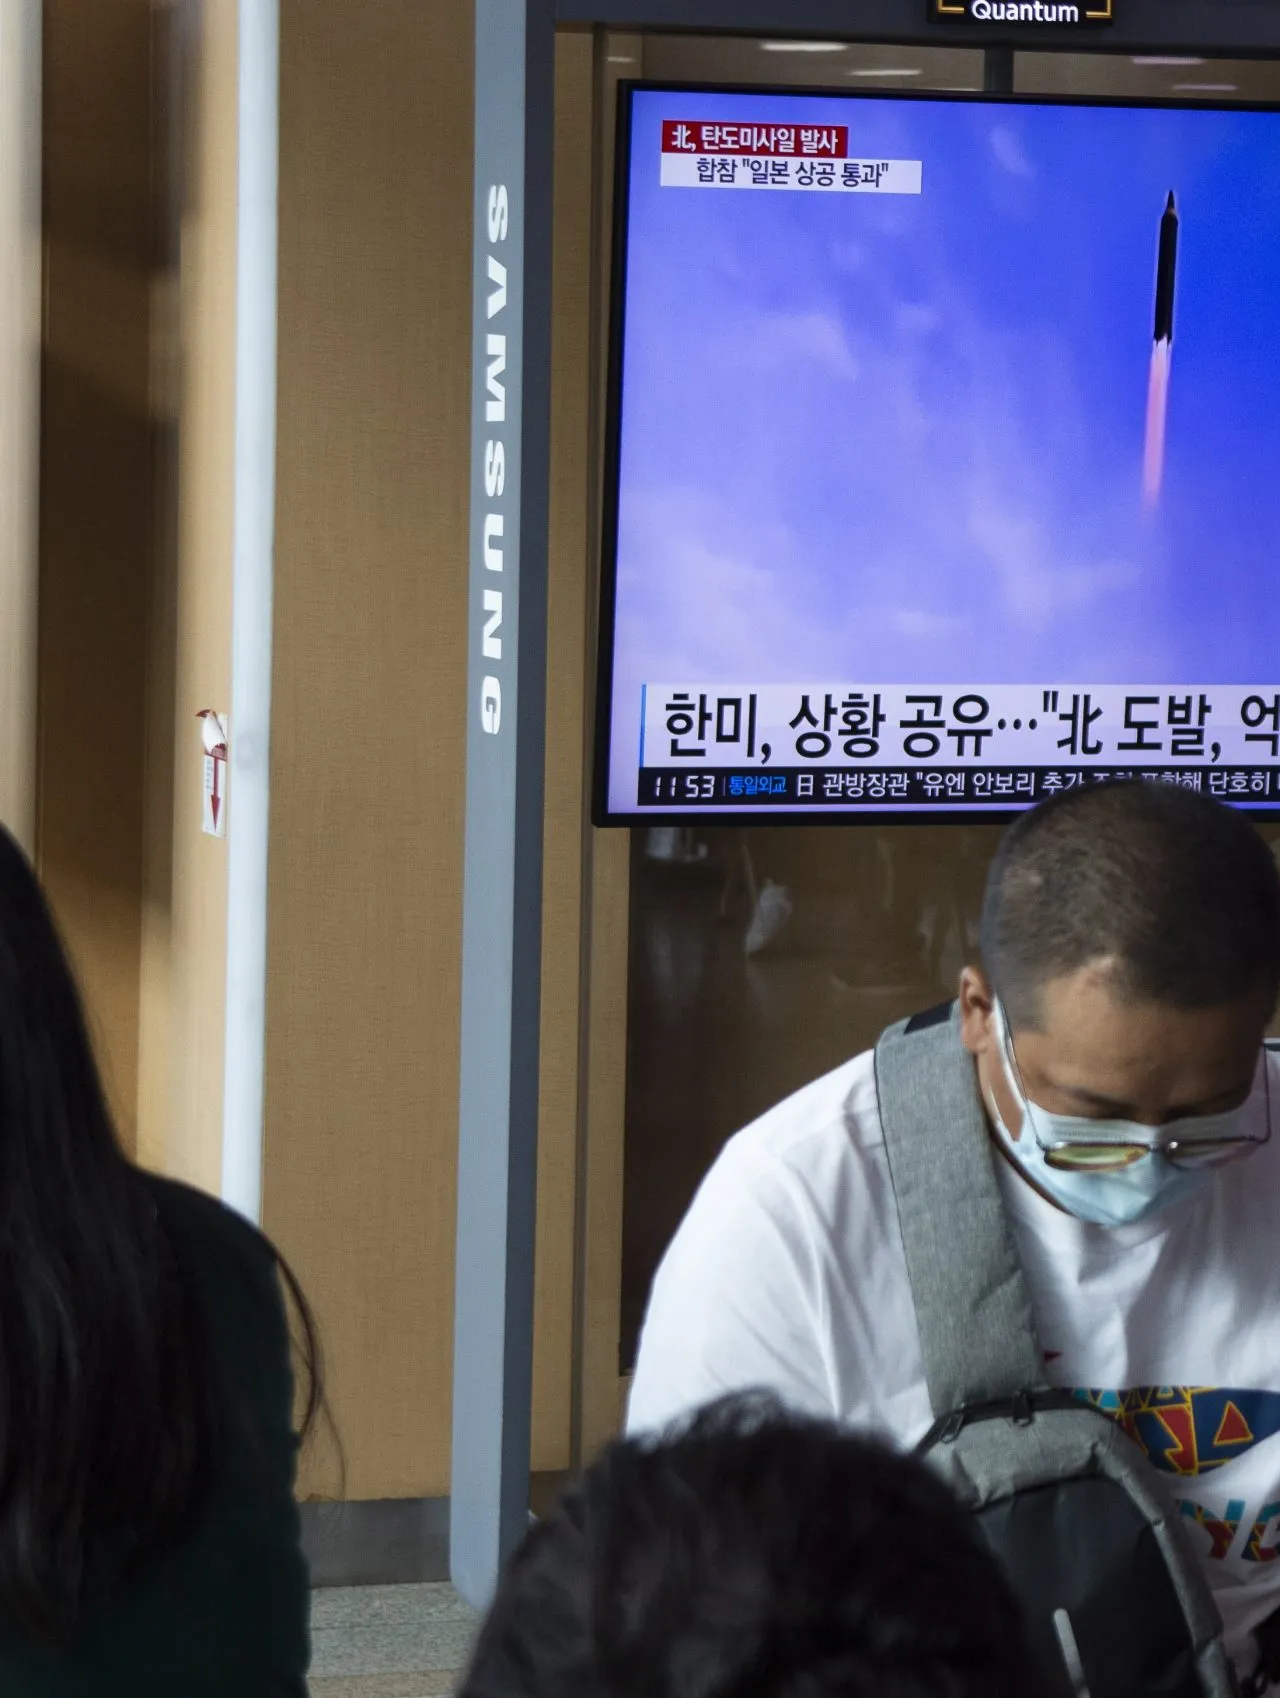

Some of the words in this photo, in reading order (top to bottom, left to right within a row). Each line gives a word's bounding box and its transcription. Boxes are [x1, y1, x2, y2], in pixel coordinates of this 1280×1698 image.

[972, 0, 1079, 23] Quantum
[671, 124, 697, 152] 北,
[701, 125, 796, 153] 탄도미사일
[800, 127, 839, 155] 발사
[696, 157, 738, 184] 합참
[742, 158, 790, 185] "일본
[795, 161, 836, 187] 상공
[840, 162, 889, 188] 통과"
[480, 183, 510, 736] SAMSUNG
[665, 693, 772, 765] 한미,
[788, 692, 887, 759] 상황
[1117, 693, 1222, 763] 도발,
[728, 774, 787, 795] 통일외교
[796, 774, 814, 796] 日
[823, 772, 910, 797] 관방장관
[916, 771, 966, 797] "유엔
[971, 771, 1036, 796] 안보리
[1208, 770, 1271, 796] 단호히
